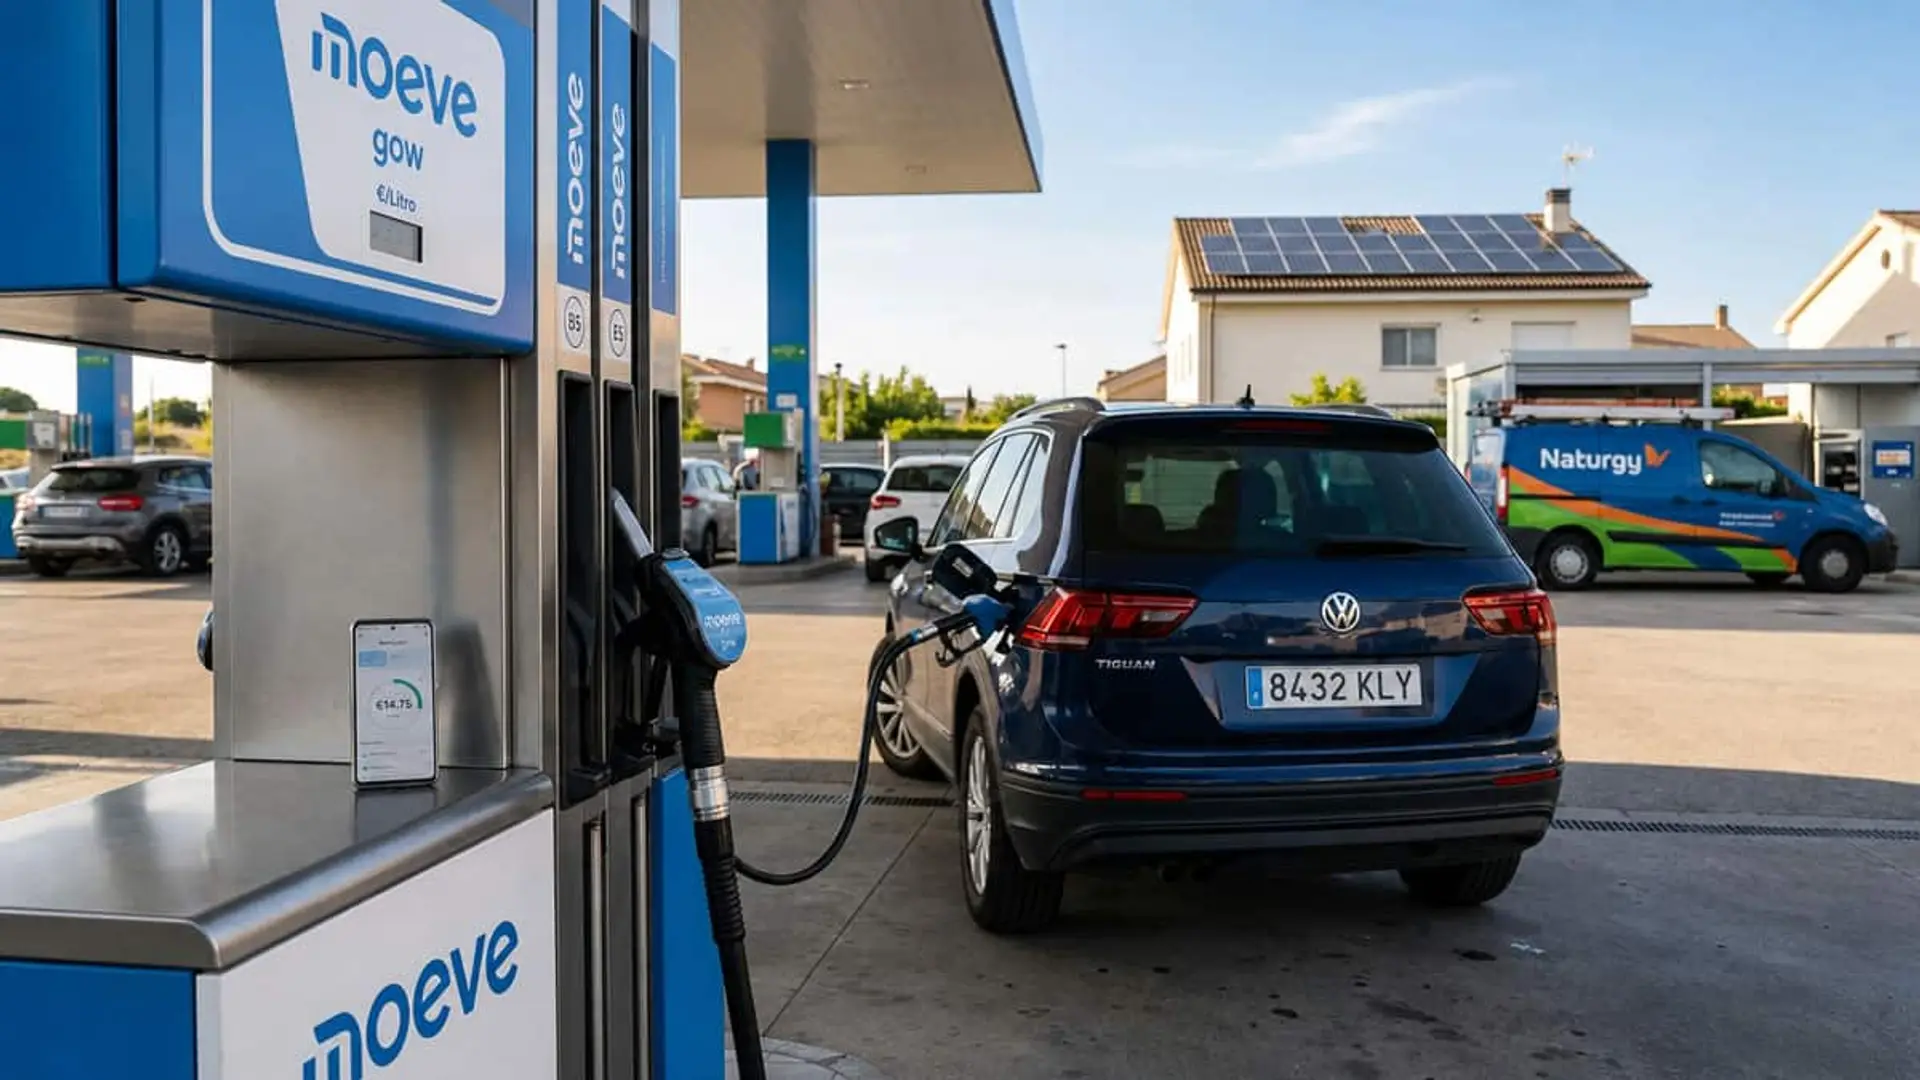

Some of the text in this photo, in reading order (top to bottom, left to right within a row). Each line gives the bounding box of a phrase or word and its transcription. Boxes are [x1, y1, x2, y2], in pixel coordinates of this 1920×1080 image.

[311, 12, 478, 138] moeve
[373, 128, 424, 170] gow
[567, 72, 584, 265] moeve
[376, 183, 417, 213] €/Litro
[611, 103, 626, 279] moeve
[1540, 448, 1642, 475] Naturgy
[1095, 658, 1156, 670] TIGUAN
[1269, 669, 1412, 702] 8432 KLY
[302, 920, 520, 1080] moeve
